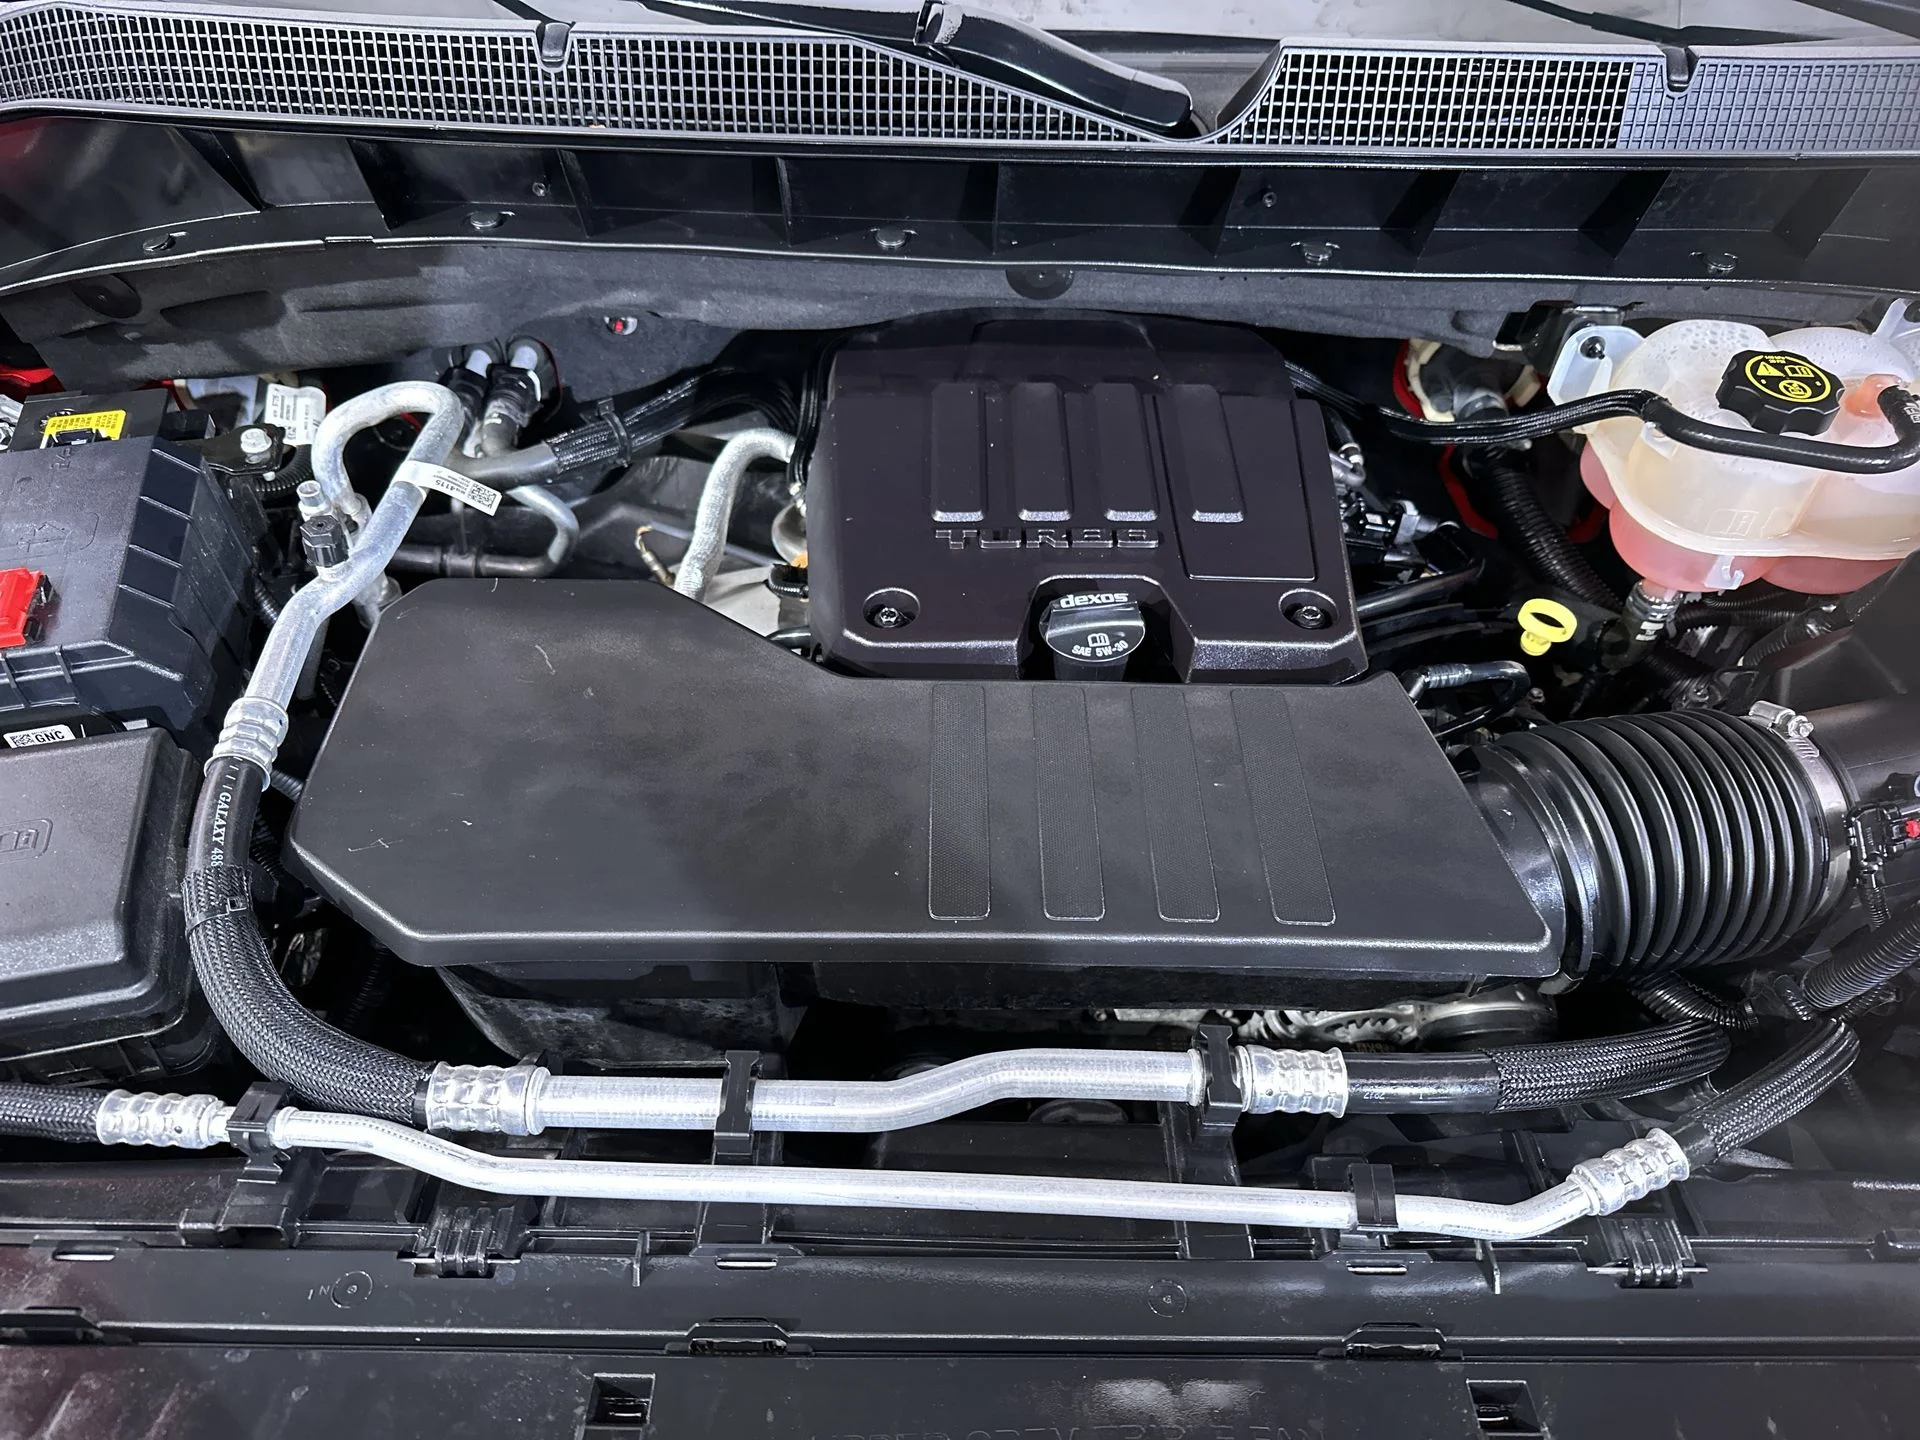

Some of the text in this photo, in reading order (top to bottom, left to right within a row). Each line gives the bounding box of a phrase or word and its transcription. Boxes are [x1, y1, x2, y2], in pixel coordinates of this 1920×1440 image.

[935, 529, 1159, 550] TURBO
[1060, 593, 1129, 609] dexos
[1071, 640, 1129, 657] SAE 5W-30
[34, 730, 65, 743] GNC
[212, 791, 232, 846] GALAXY
